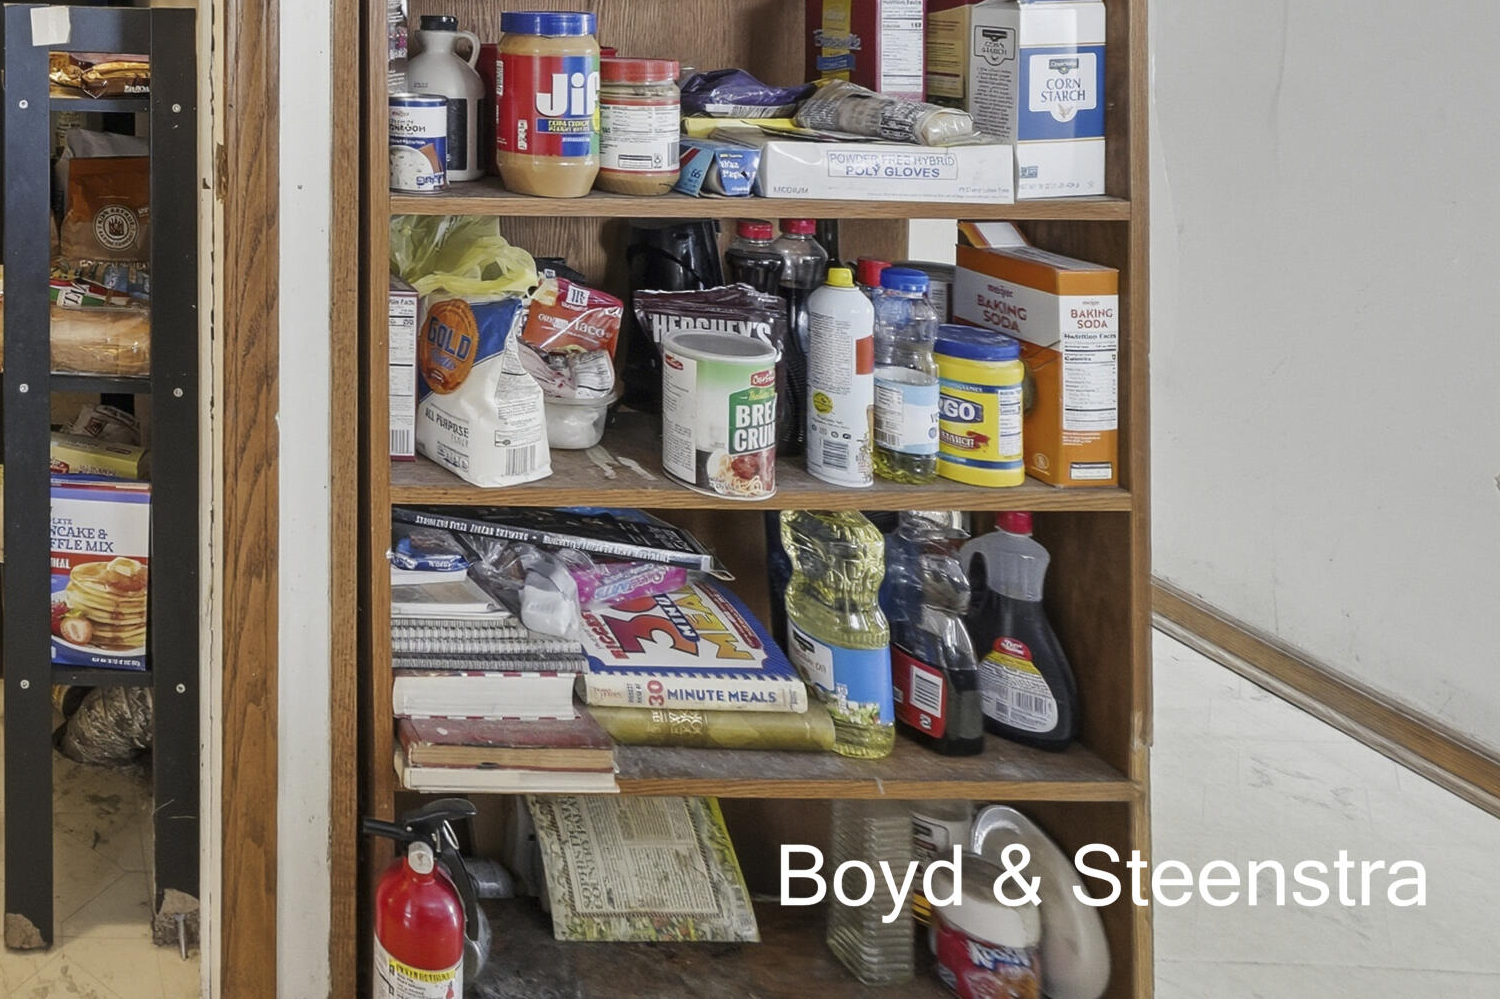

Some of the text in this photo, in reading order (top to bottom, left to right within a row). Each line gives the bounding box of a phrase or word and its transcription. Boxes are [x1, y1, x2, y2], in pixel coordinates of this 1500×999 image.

[536, 72, 600, 117] Jif
[1046, 77, 1082, 90] CORN
[1040, 89, 1086, 103] STARCH
[830, 153, 877, 167] POWDER
[913, 153, 955, 167] HYBRID
[845, 164, 940, 178] POLY GLOVES
[722, 170, 747, 180] Pap
[976, 294, 1028, 322] BAKING
[1070, 308, 1114, 319] BAKING
[983, 310, 1021, 333] SODA
[1077, 319, 1109, 329] SODA
[427, 316, 472, 362] GOLD
[735, 400, 776, 428] BREA
[940, 398, 976, 421] GO
[436, 412, 469, 438] PURPOSE
[734, 423, 776, 452] CRUM
[50, 525, 108, 540] NCAKE &
[50, 538, 114, 553] FFLE MIX
[654, 593, 700, 642] MINU
[666, 585, 755, 661] MEA
[647, 679, 777, 707] 30 MINUTE MEALS
[560, 796, 591, 909] SOPHISTICAT
